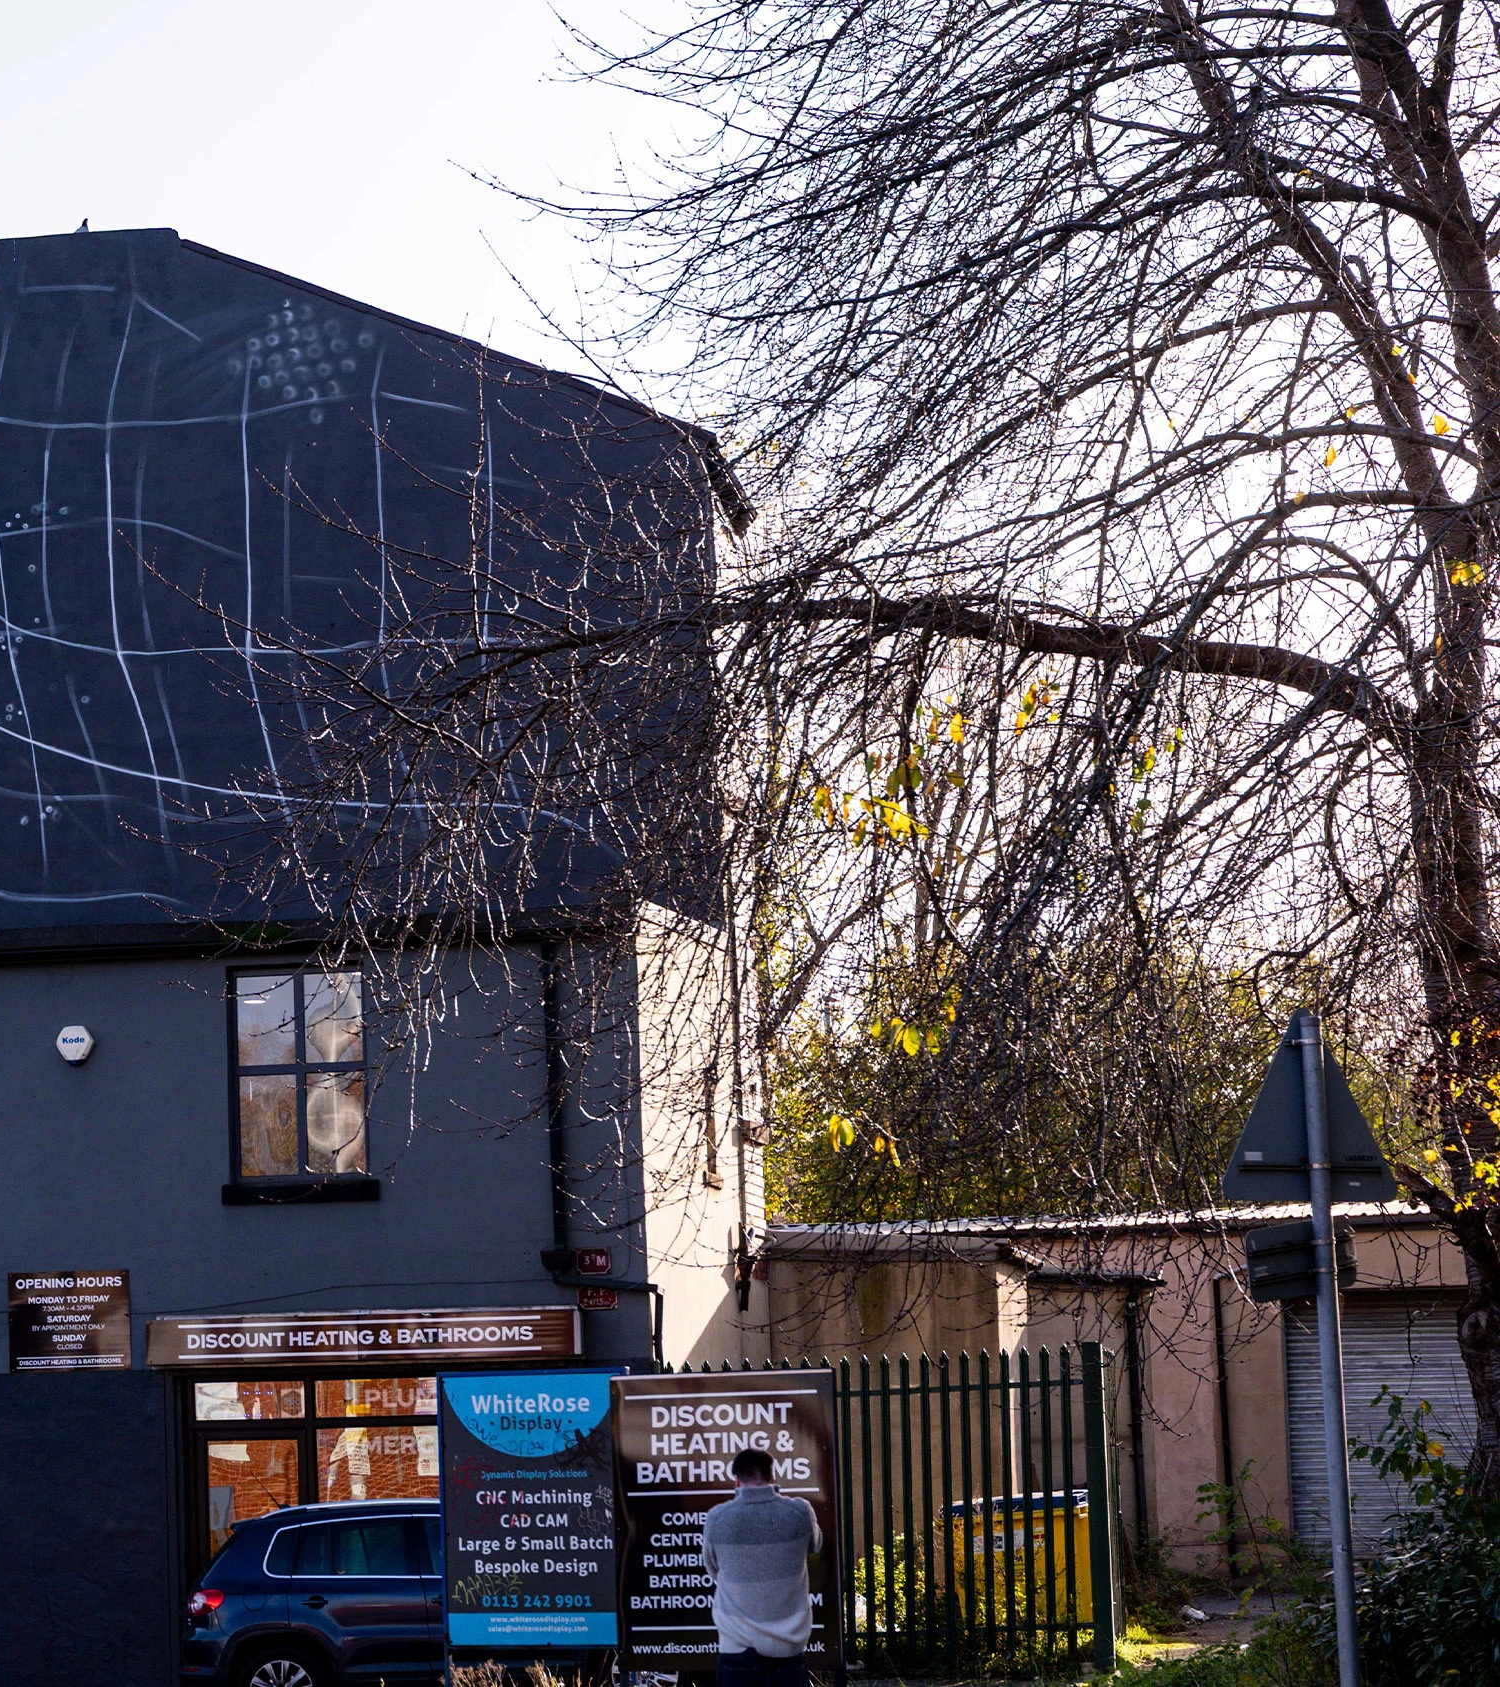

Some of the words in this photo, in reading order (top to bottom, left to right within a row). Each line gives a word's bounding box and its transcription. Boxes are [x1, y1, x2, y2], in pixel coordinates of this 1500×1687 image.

[15, 1277, 74, 1290] OPENING
[77, 1276, 122, 1288] HOURS
[28, 1296, 65, 1304] MONDAY
[66, 1295, 77, 1303] TO
[47, 1315, 91, 1323] SATURDAY
[52, 1334, 86, 1342] SUNDAY
[187, 1331, 285, 1350] DISCOUNT
[289, 1329, 375, 1347] HEATING
[379, 1328, 392, 1345] &
[397, 1325, 534, 1344] BATHROOMS
[364, 1387, 437, 1408] PLUM
[471, 1393, 591, 1414] WhiteRose
[651, 1402, 793, 1429] DISCOUNT
[500, 1416, 562, 1434] Display
[651, 1431, 771, 1456] HEATING
[775, 1430, 795, 1453] &
[516, 1469, 547, 1481] Display
[549, 1469, 588, 1479] Solutions
[636, 1458, 811, 1484] BATHRMS
[476, 1491, 507, 1505] CNC
[512, 1489, 593, 1507] Machining
[500, 1513, 531, 1528] CAD
[535, 1513, 569, 1527] CAM
[661, 1512, 708, 1525] COMB
[458, 1537, 500, 1555] Large
[505, 1536, 516, 1550] &
[521, 1536, 565, 1550] Small
[569, 1535, 614, 1550] Batch
[650, 1533, 704, 1547] CENTR
[474, 1559, 539, 1577] Bespoke
[544, 1558, 598, 1577] Design
[643, 1554, 705, 1568] PLUMBI
[649, 1575, 712, 1588] BATHRO
[482, 1595, 519, 1608] 0113
[524, 1594, 551, 1607] 242
[555, 1594, 593, 1608] 9901
[490, 1616, 585, 1624] www.whiterosedisplay.com
[488, 1625, 589, 1633] sales@whiterosedisplay.com
